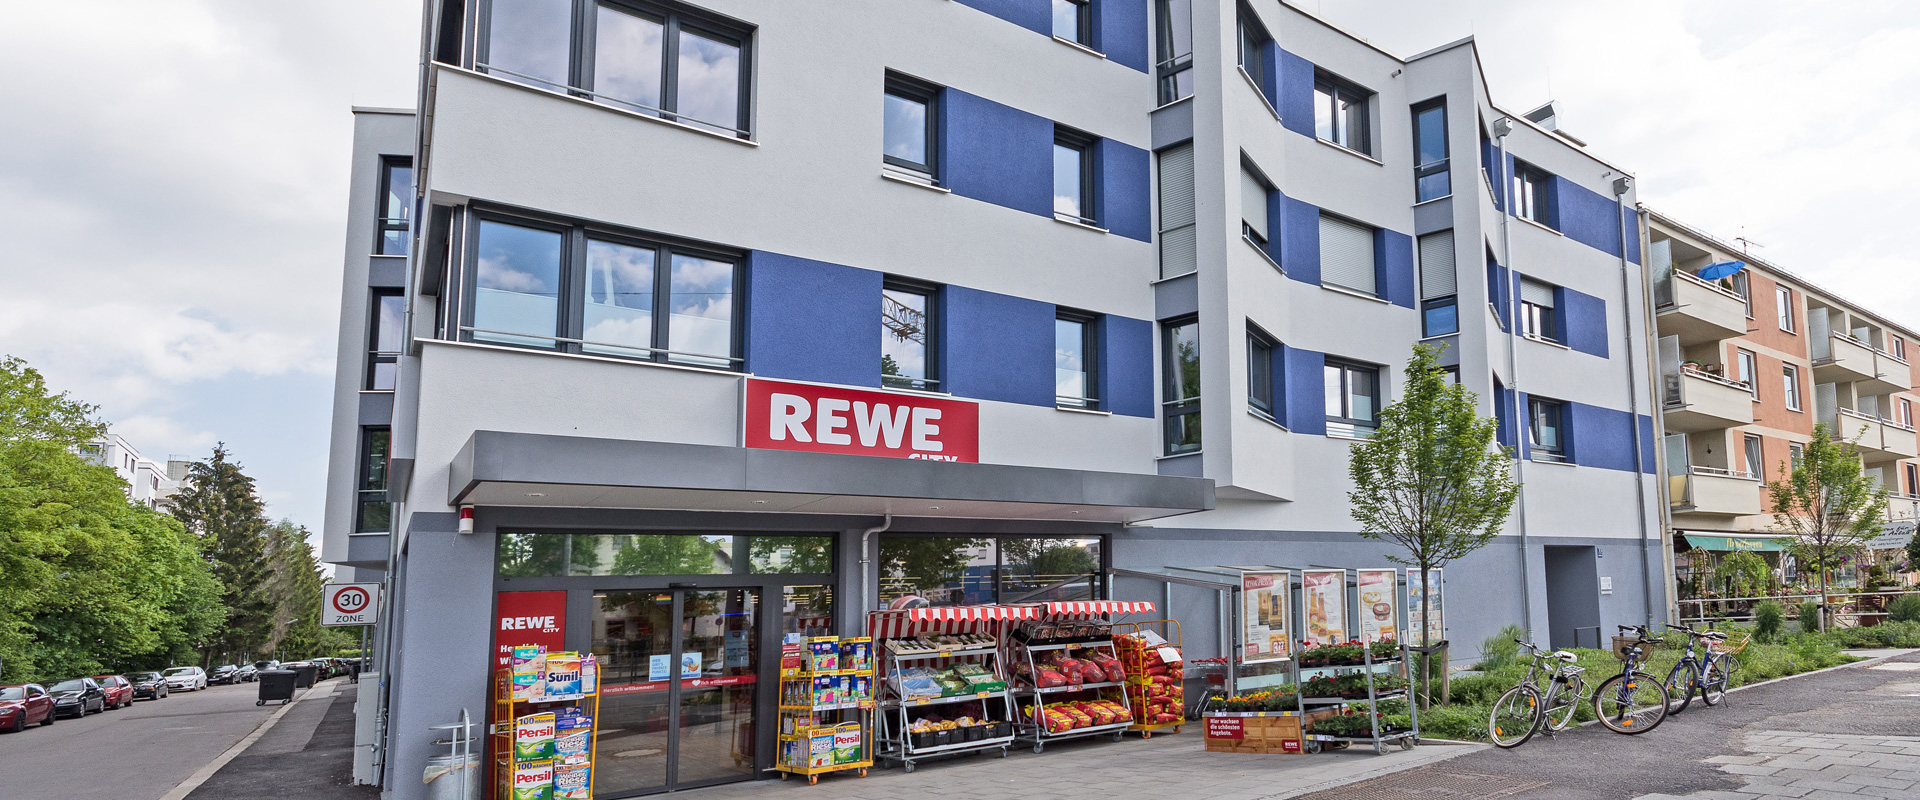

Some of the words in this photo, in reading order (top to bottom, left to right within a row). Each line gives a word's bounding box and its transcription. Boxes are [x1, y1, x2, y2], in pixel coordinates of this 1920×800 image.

[769, 392, 943, 452] REWE
[340, 594, 362, 606] 30
[336, 615, 364, 623] ZONE
[501, 616, 555, 630] REWE
[548, 670, 579, 682] Sunil
[624, 684, 655, 692] willkommen!
[519, 717, 535, 725] 100
[518, 726, 553, 738] Persil
[835, 734, 859, 744] Persil
[557, 740, 586, 750] Riese
[517, 762, 532, 770] 100
[516, 770, 551, 784] Persil
[558, 776, 586, 786] Riese
